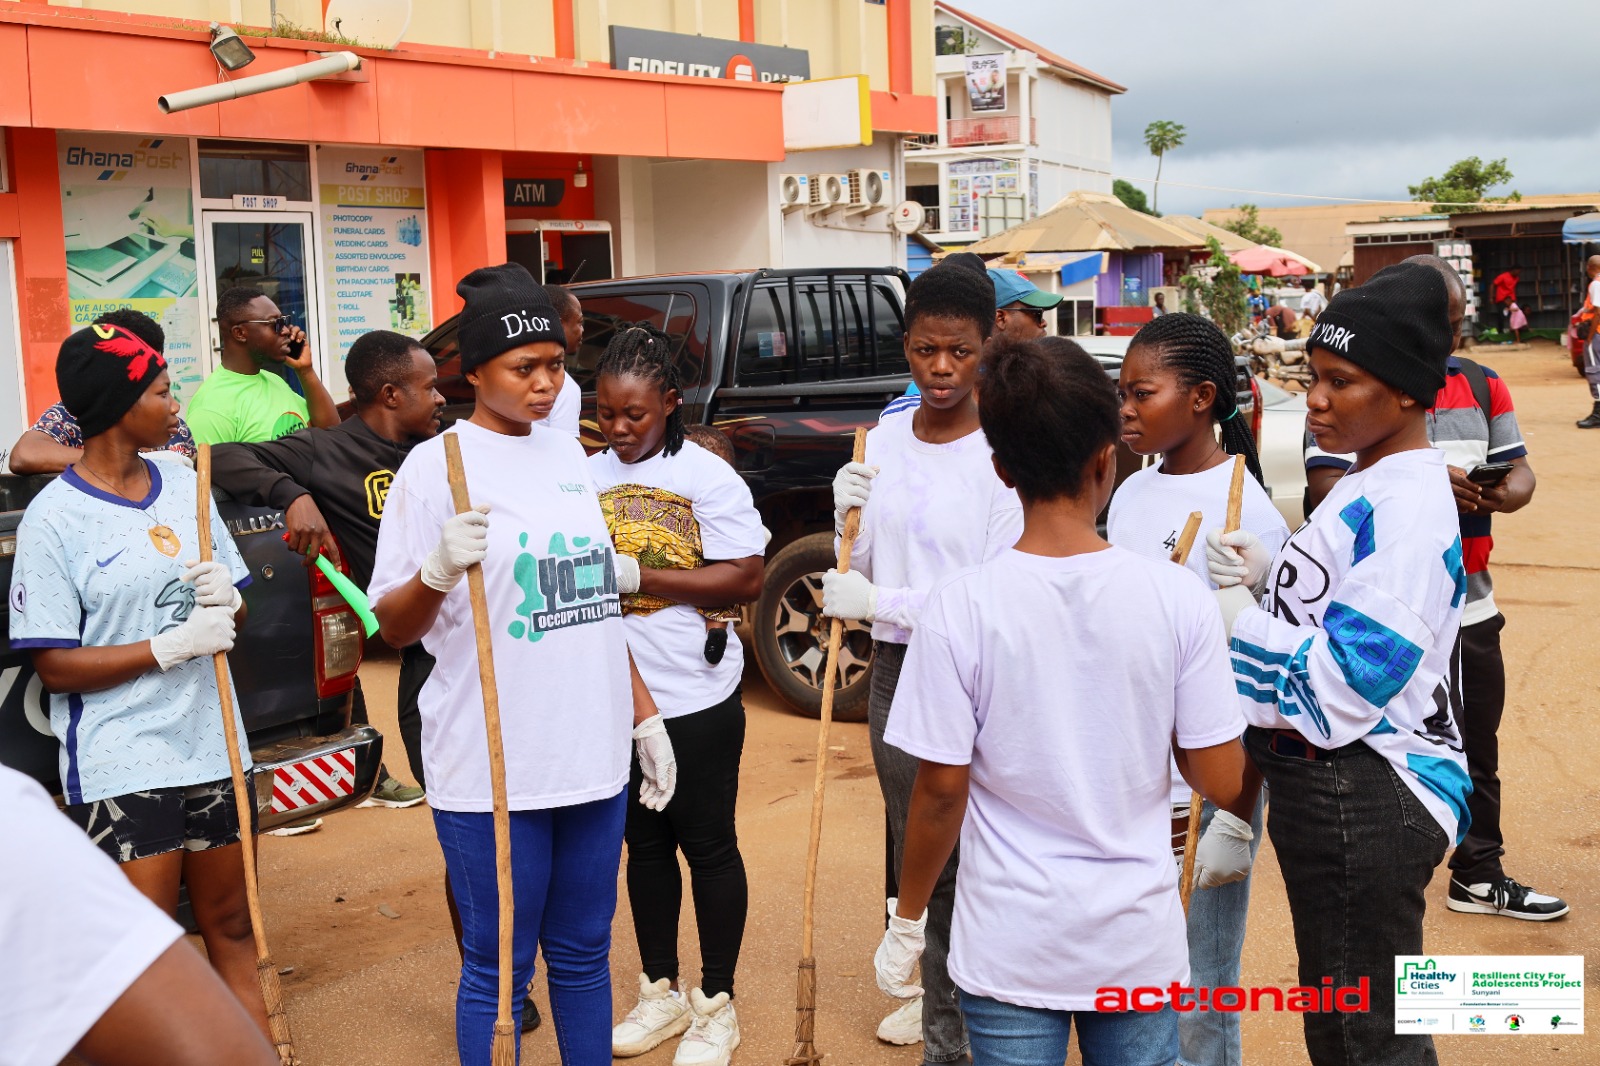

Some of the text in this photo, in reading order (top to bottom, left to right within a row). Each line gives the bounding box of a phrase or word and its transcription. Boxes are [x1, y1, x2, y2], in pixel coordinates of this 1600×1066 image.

[66, 147, 183, 170] GhanaPost
[345, 162, 405, 175] GhanaPost
[338, 186, 410, 204] POST SHOP
[514, 184, 545, 202] ATM
[242, 197, 278, 209] POST SHOP
[334, 227, 364, 235] FUNERAL
[251, 248, 265, 257] PULL
[74, 304, 90, 312] WE
[92, 303, 116, 312] ALSO
[337, 303, 360, 311] T-ROLL
[500, 310, 551, 339] Dior
[1316, 323, 1356, 353] YORK
[538, 609, 580, 629] OCCUPY
[580, 605, 603, 621] TILL
